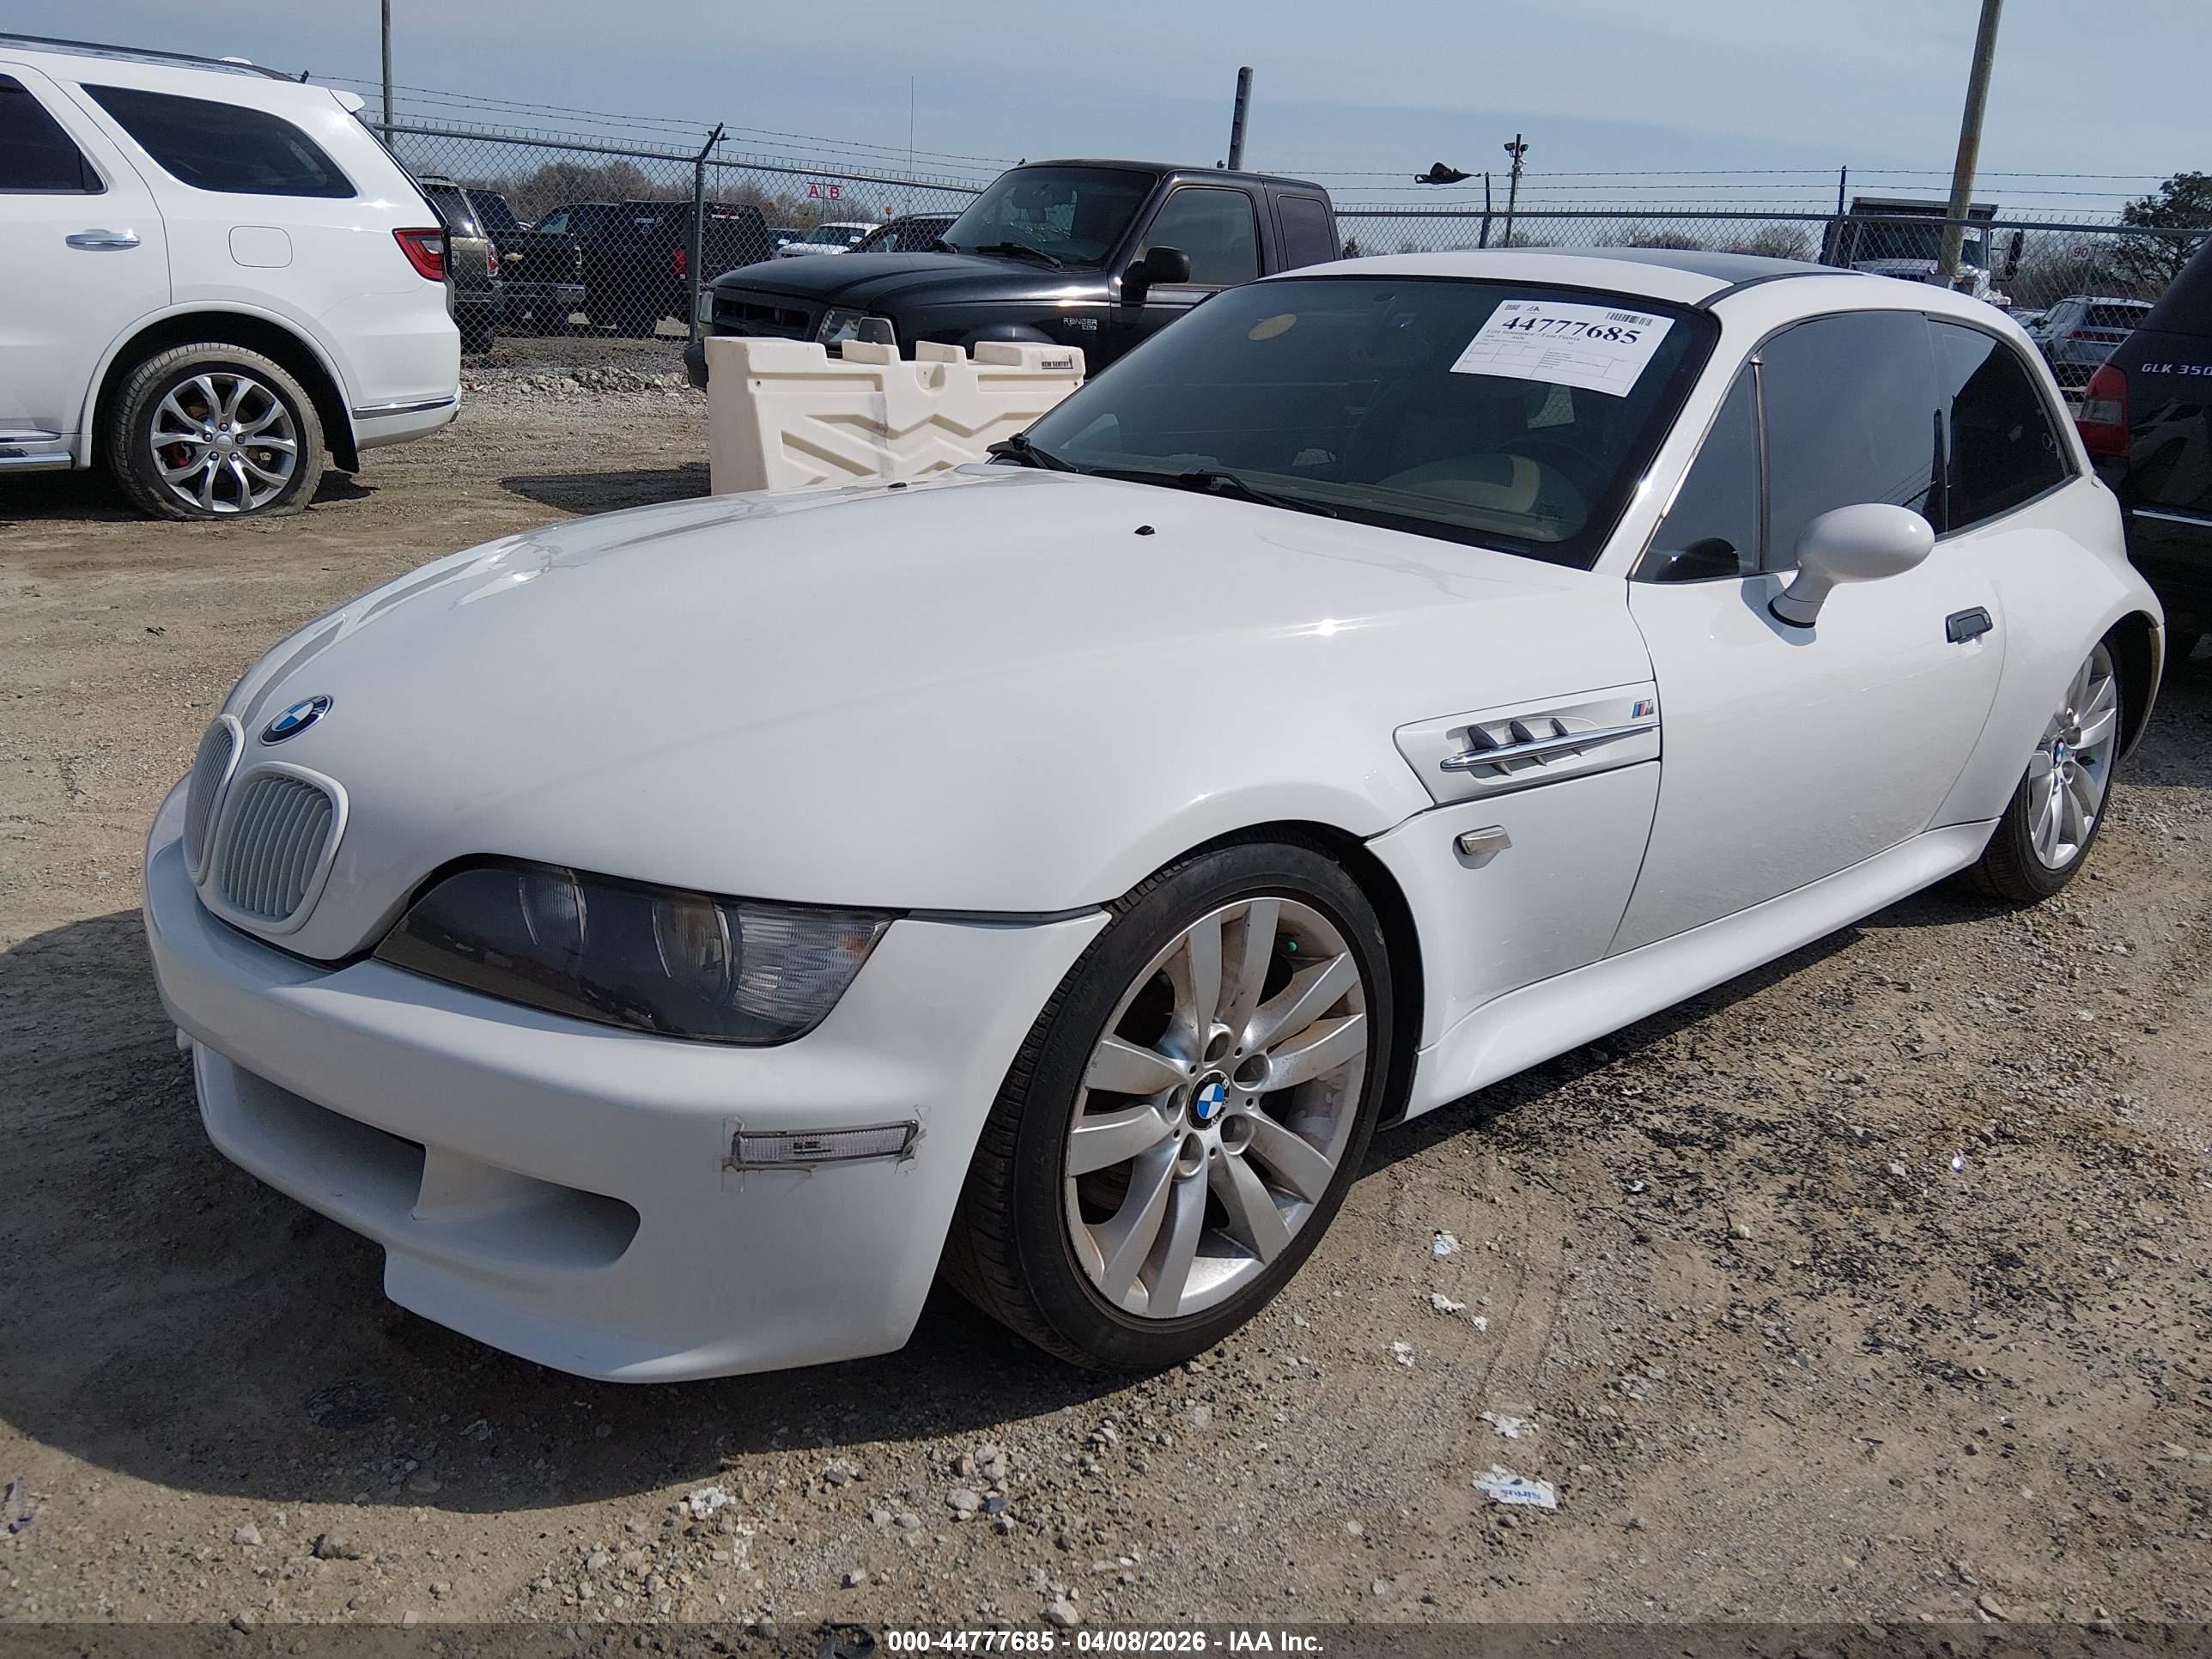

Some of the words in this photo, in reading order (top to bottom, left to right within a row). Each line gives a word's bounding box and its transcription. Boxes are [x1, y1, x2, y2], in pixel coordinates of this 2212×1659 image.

[809, 185, 819, 197] A
[830, 186, 840, 198] B
[2074, 246, 2089, 258] 90
[1063, 317, 1097, 326] RANGER
[1501, 315, 1643, 345] 44777685
[2141, 363, 2173, 374] GLK
[2177, 364, 2212, 376] 350
